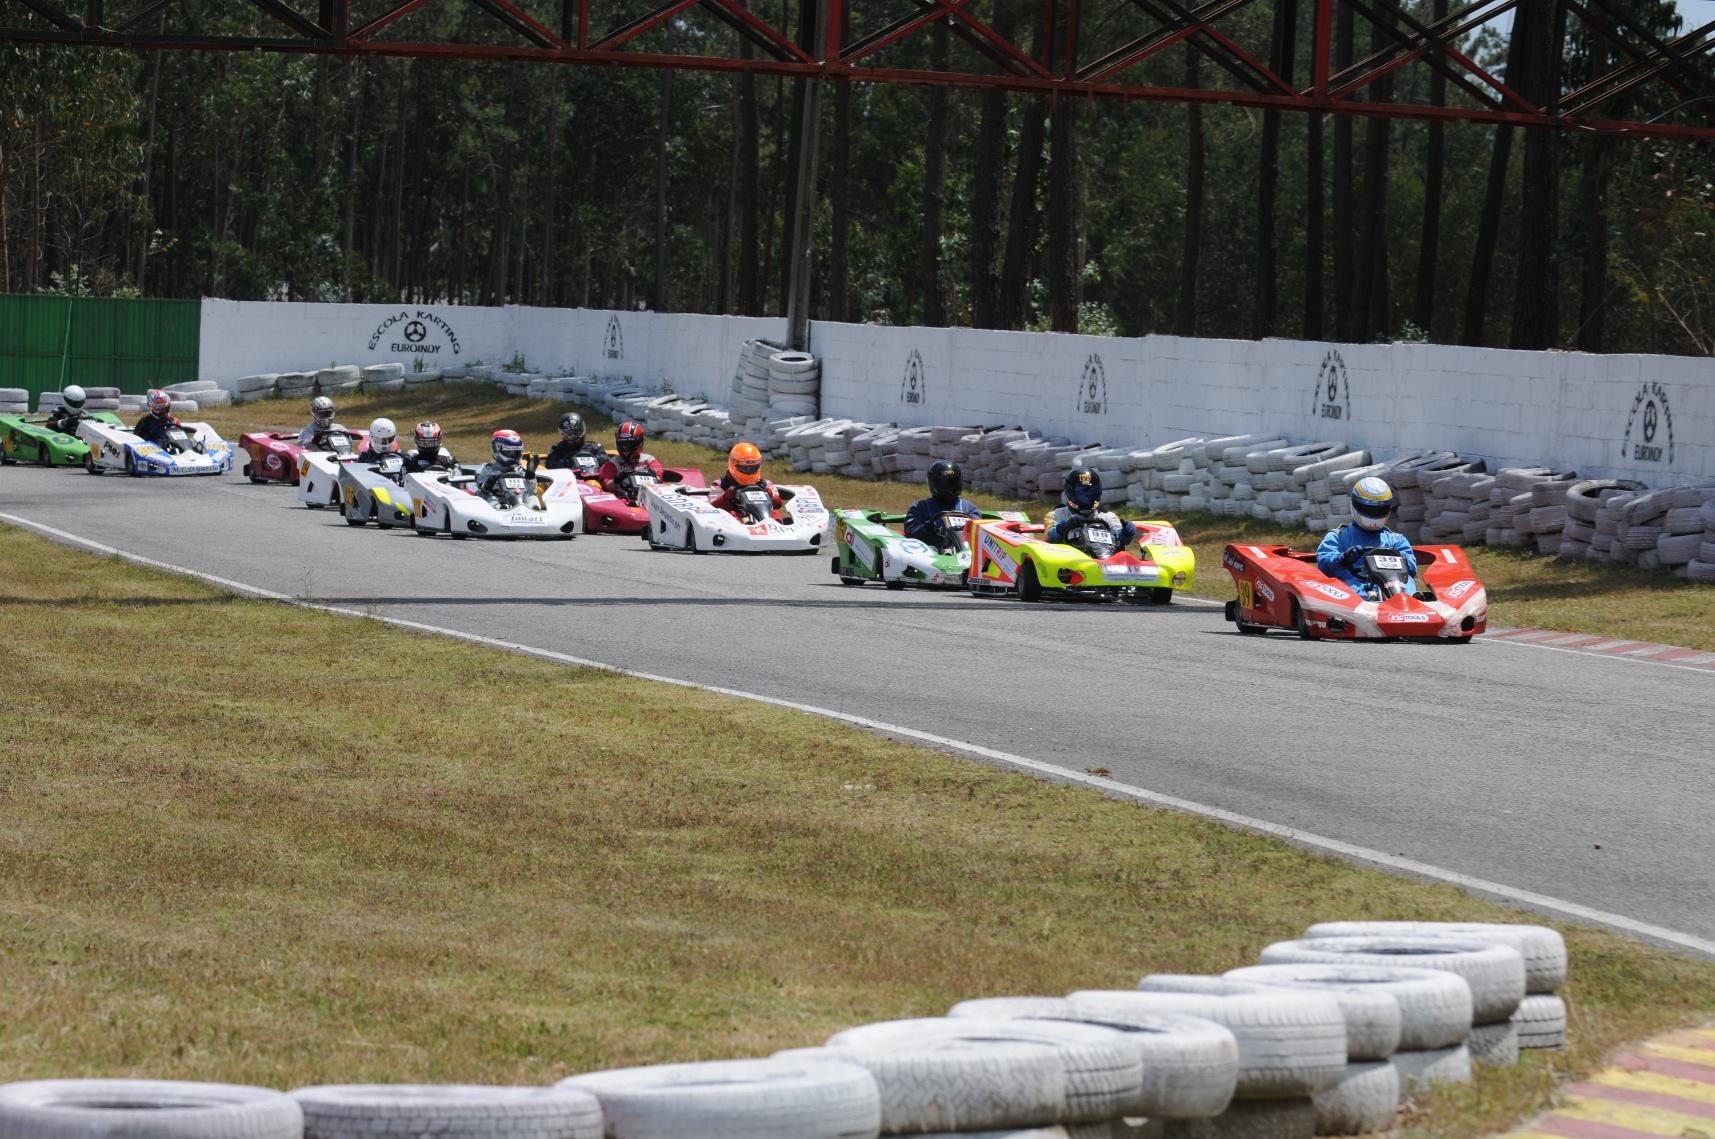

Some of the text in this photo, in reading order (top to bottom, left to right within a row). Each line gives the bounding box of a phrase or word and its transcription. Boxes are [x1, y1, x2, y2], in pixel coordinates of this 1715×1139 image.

[367, 310, 462, 355] ESCOLA KARTING
[391, 343, 441, 353] EUROINDY
[984, 533, 1008, 560] UNITRIP
[1239, 582, 1251, 607] 39
